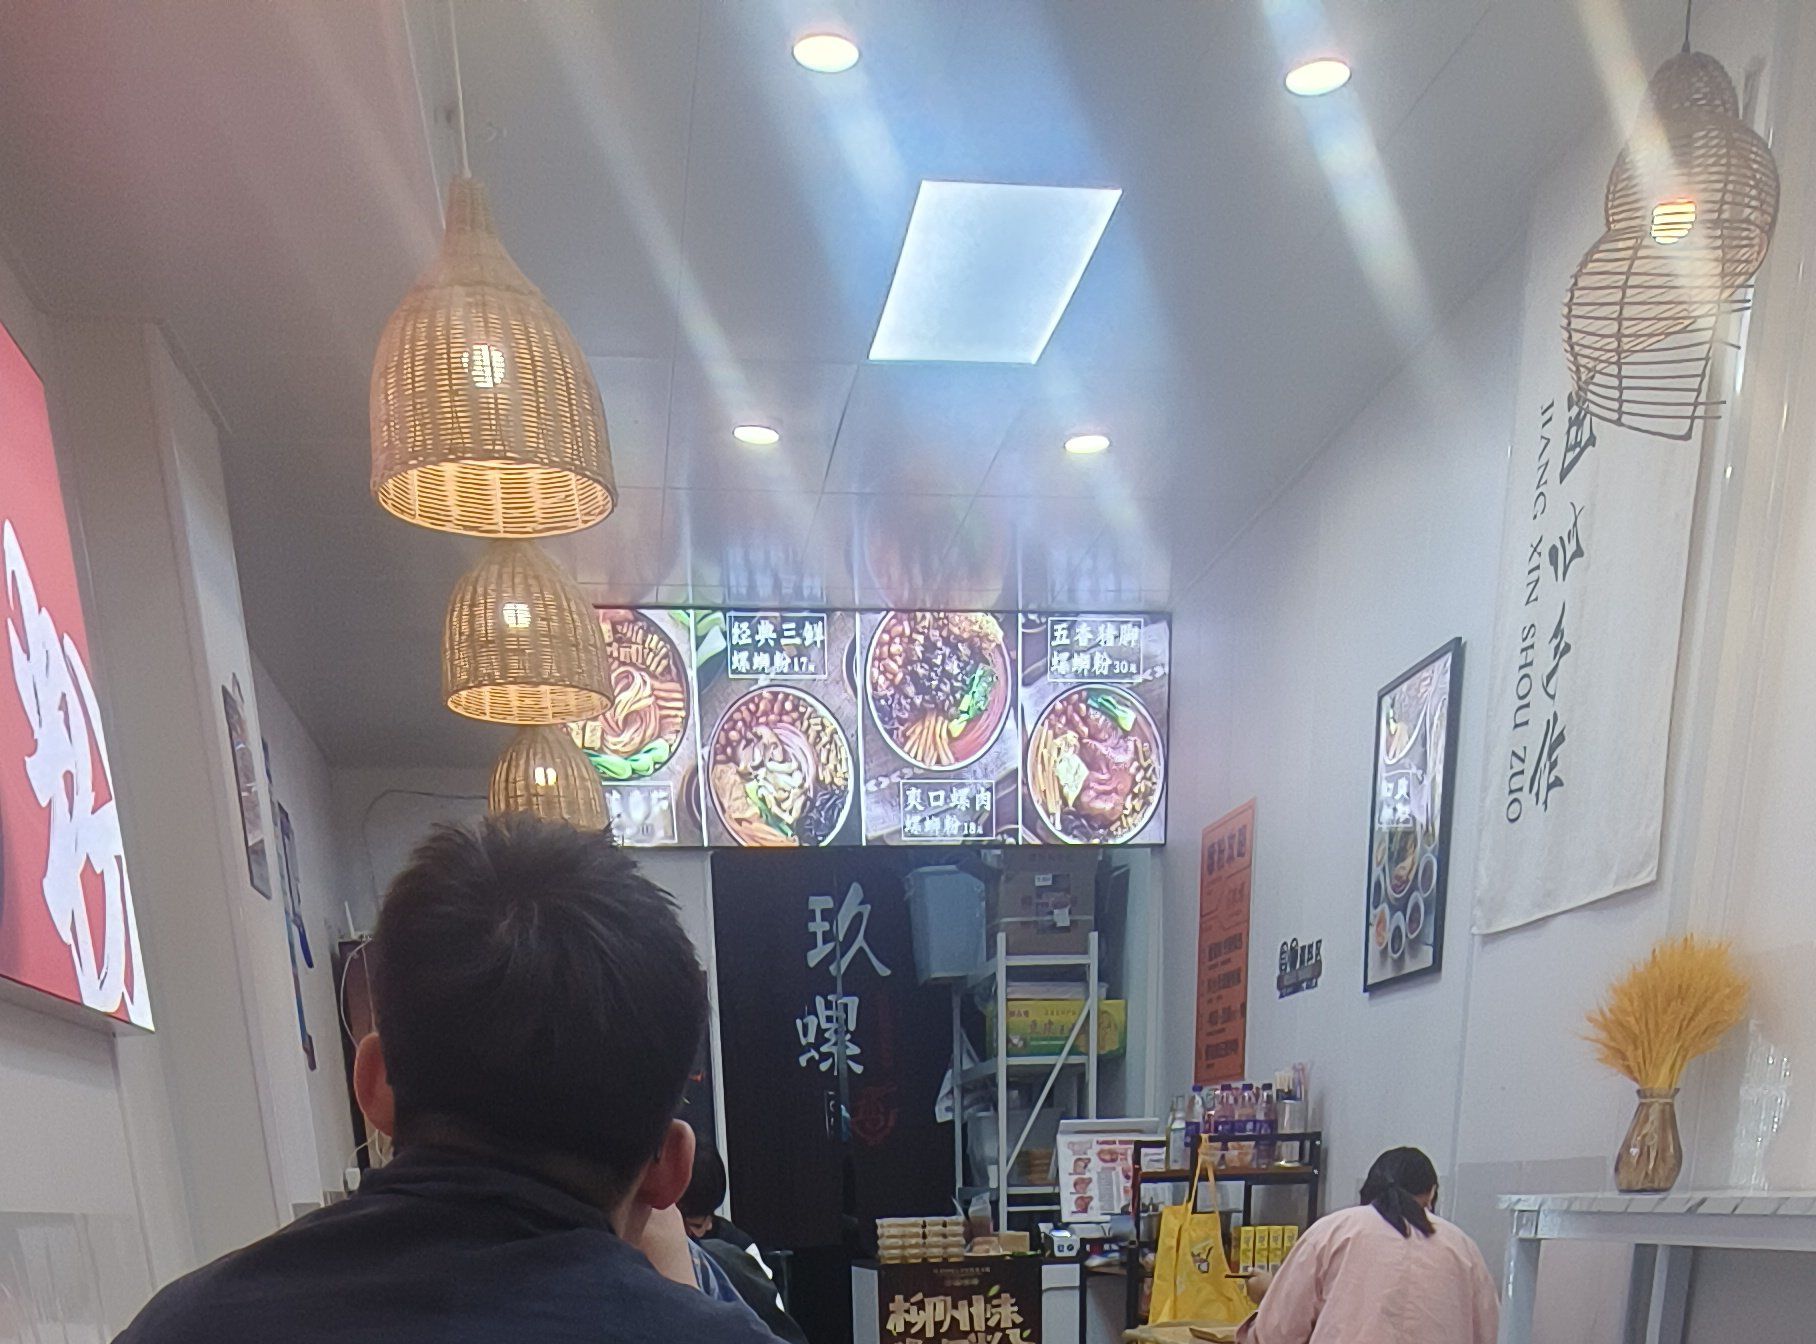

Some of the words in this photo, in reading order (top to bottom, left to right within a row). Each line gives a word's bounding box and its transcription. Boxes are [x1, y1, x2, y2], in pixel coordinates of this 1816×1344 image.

[1532, 398, 1555, 521] JIANG
[1524, 535, 1544, 607] XIN
[1512, 623, 1537, 731] SHOU
[1505, 745, 1528, 825] ZUO
